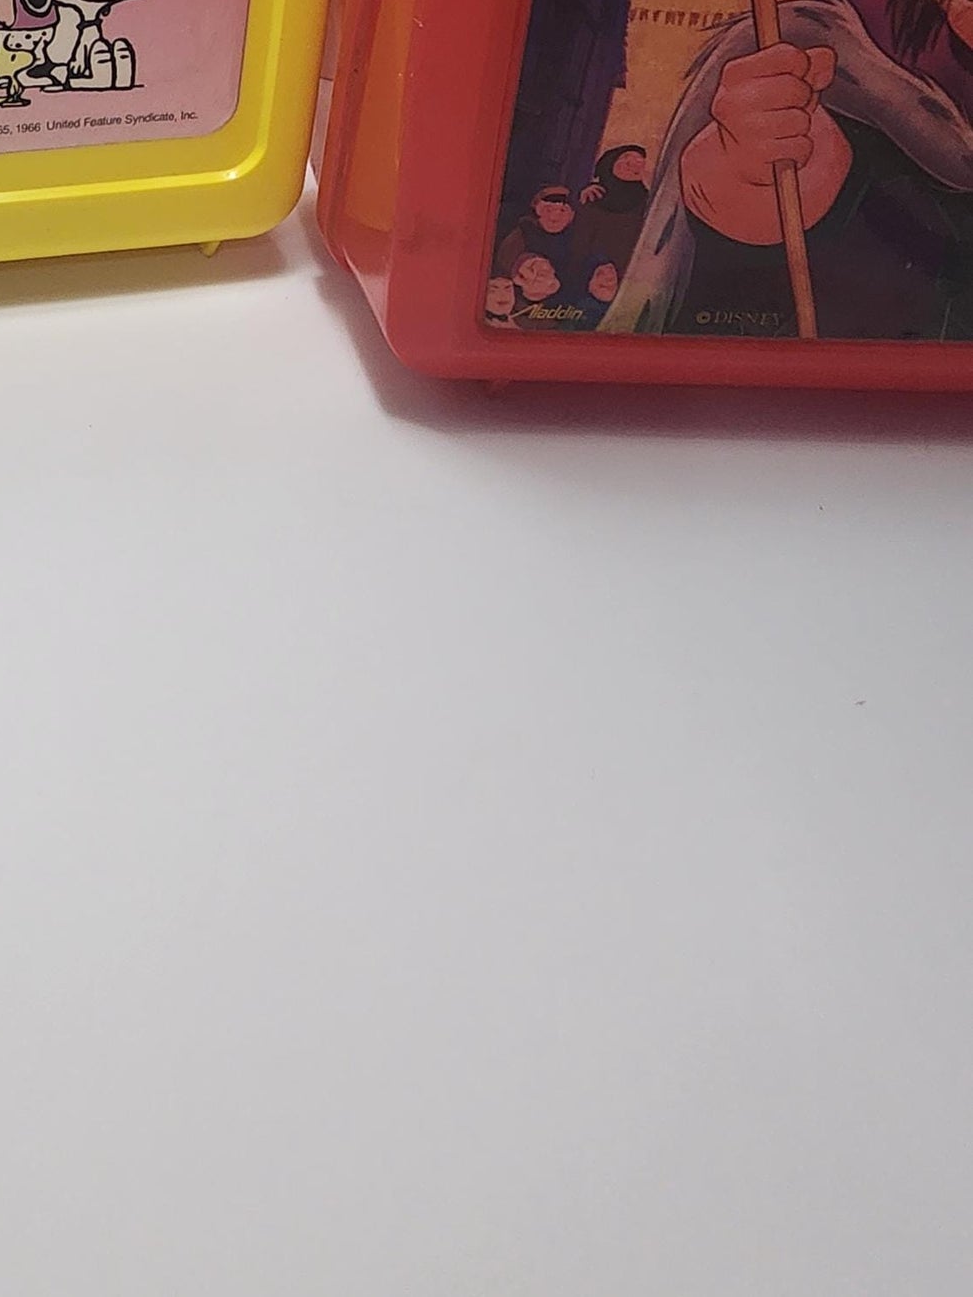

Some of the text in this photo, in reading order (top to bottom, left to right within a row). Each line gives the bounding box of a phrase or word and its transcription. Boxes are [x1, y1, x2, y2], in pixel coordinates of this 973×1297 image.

[16, 122, 41, 133] 1966
[46, 118, 81, 131] United
[83, 115, 122, 128] Feature
[124, 112, 177, 126] Syndicate,
[180, 110, 199, 121] Inc.
[508, 303, 584, 320] Aladdin
